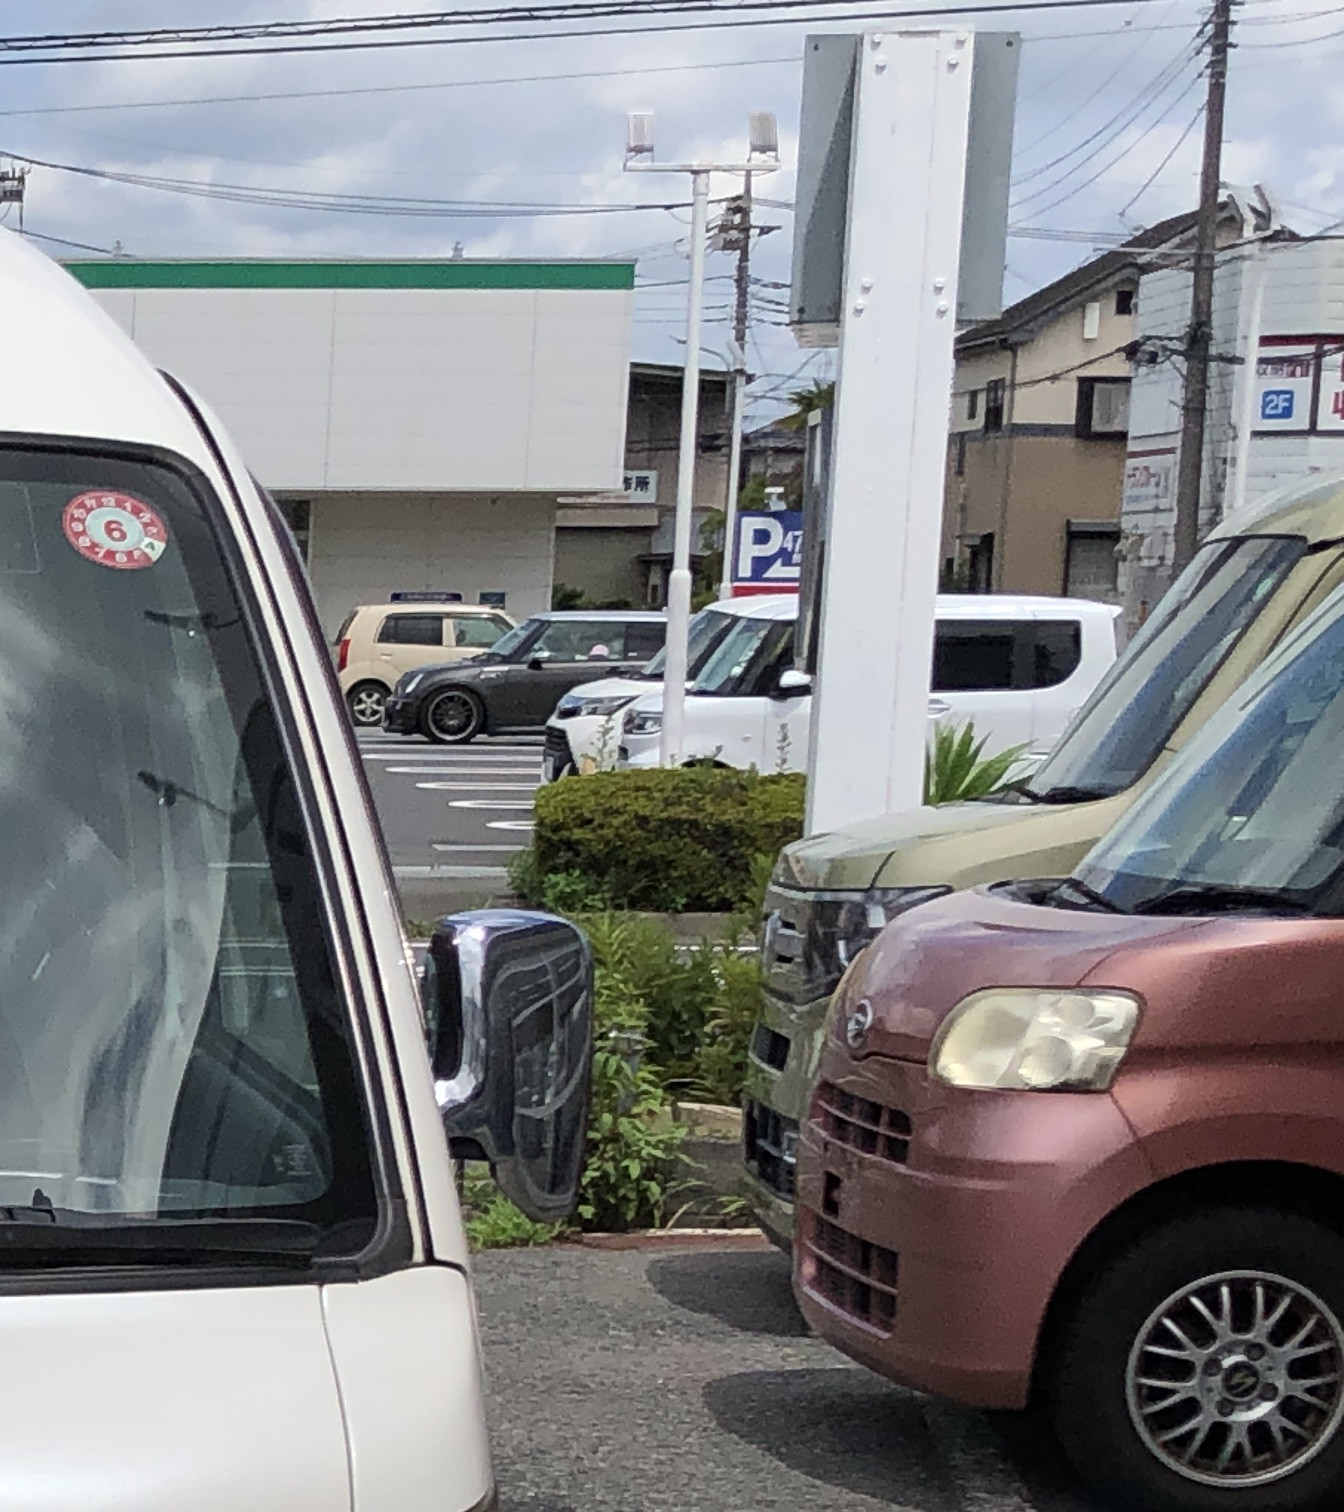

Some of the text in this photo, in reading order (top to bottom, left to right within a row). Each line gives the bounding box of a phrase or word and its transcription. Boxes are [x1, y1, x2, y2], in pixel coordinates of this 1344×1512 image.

[1263, 394, 1292, 414] 2F
[104, 519, 127, 542] 6
[738, 516, 784, 578] P
